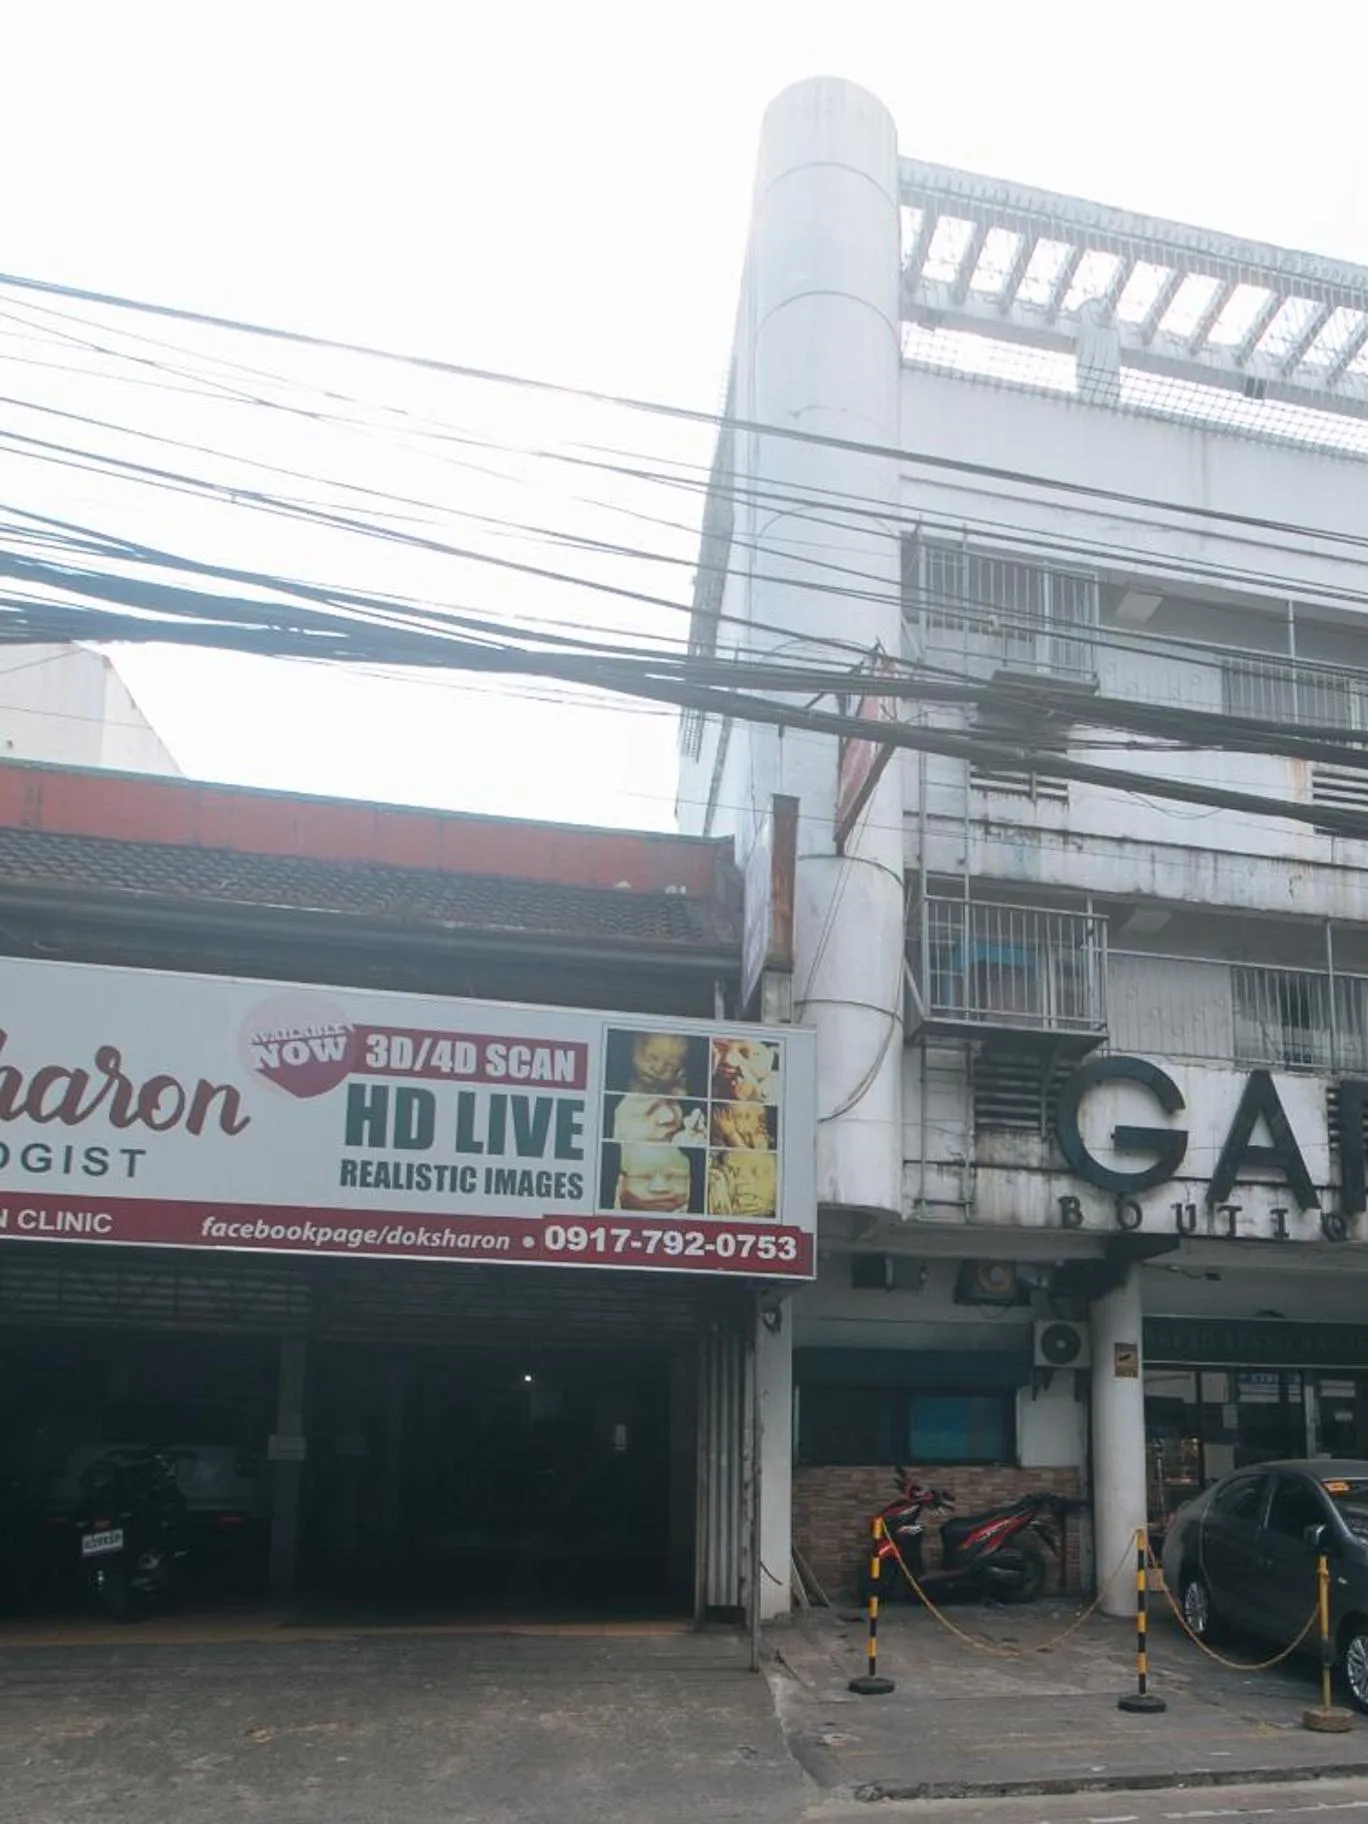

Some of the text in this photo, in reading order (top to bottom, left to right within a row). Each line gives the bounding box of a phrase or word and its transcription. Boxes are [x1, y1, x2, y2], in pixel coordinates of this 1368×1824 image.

[247, 1035, 349, 1070] NOW
[365, 1033, 576, 1082] 3D/4D SCAN
[0, 1027, 252, 1136] haron
[344, 1082, 585, 1161] HD LIVE
[340, 1158, 584, 1201] REALISTIC IMAGES
[17, 1208, 114, 1234] CLINIC
[200, 1215, 798, 1262] facebookpage/doksharon 0917-792-0753
